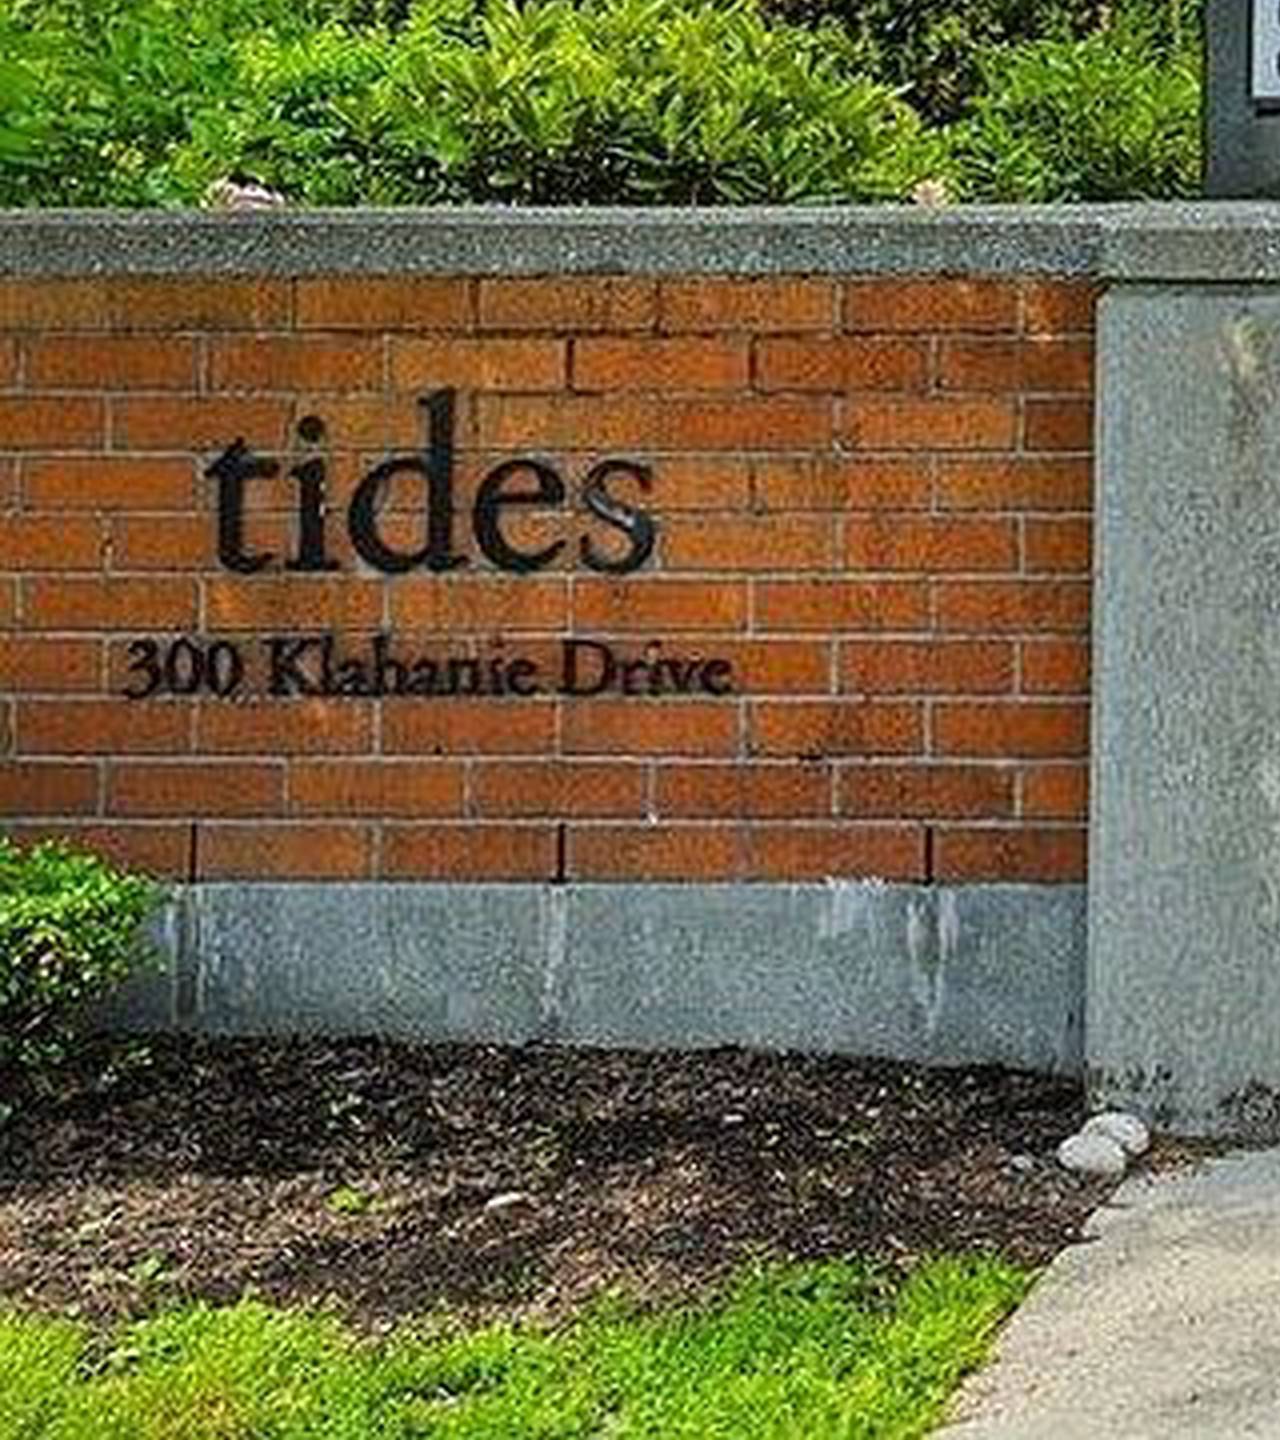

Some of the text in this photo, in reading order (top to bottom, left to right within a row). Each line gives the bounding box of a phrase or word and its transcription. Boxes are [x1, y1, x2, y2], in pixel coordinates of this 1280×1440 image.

[204, 386, 659, 574] tides
[125, 634, 735, 698] 300 Klahanie Drive
